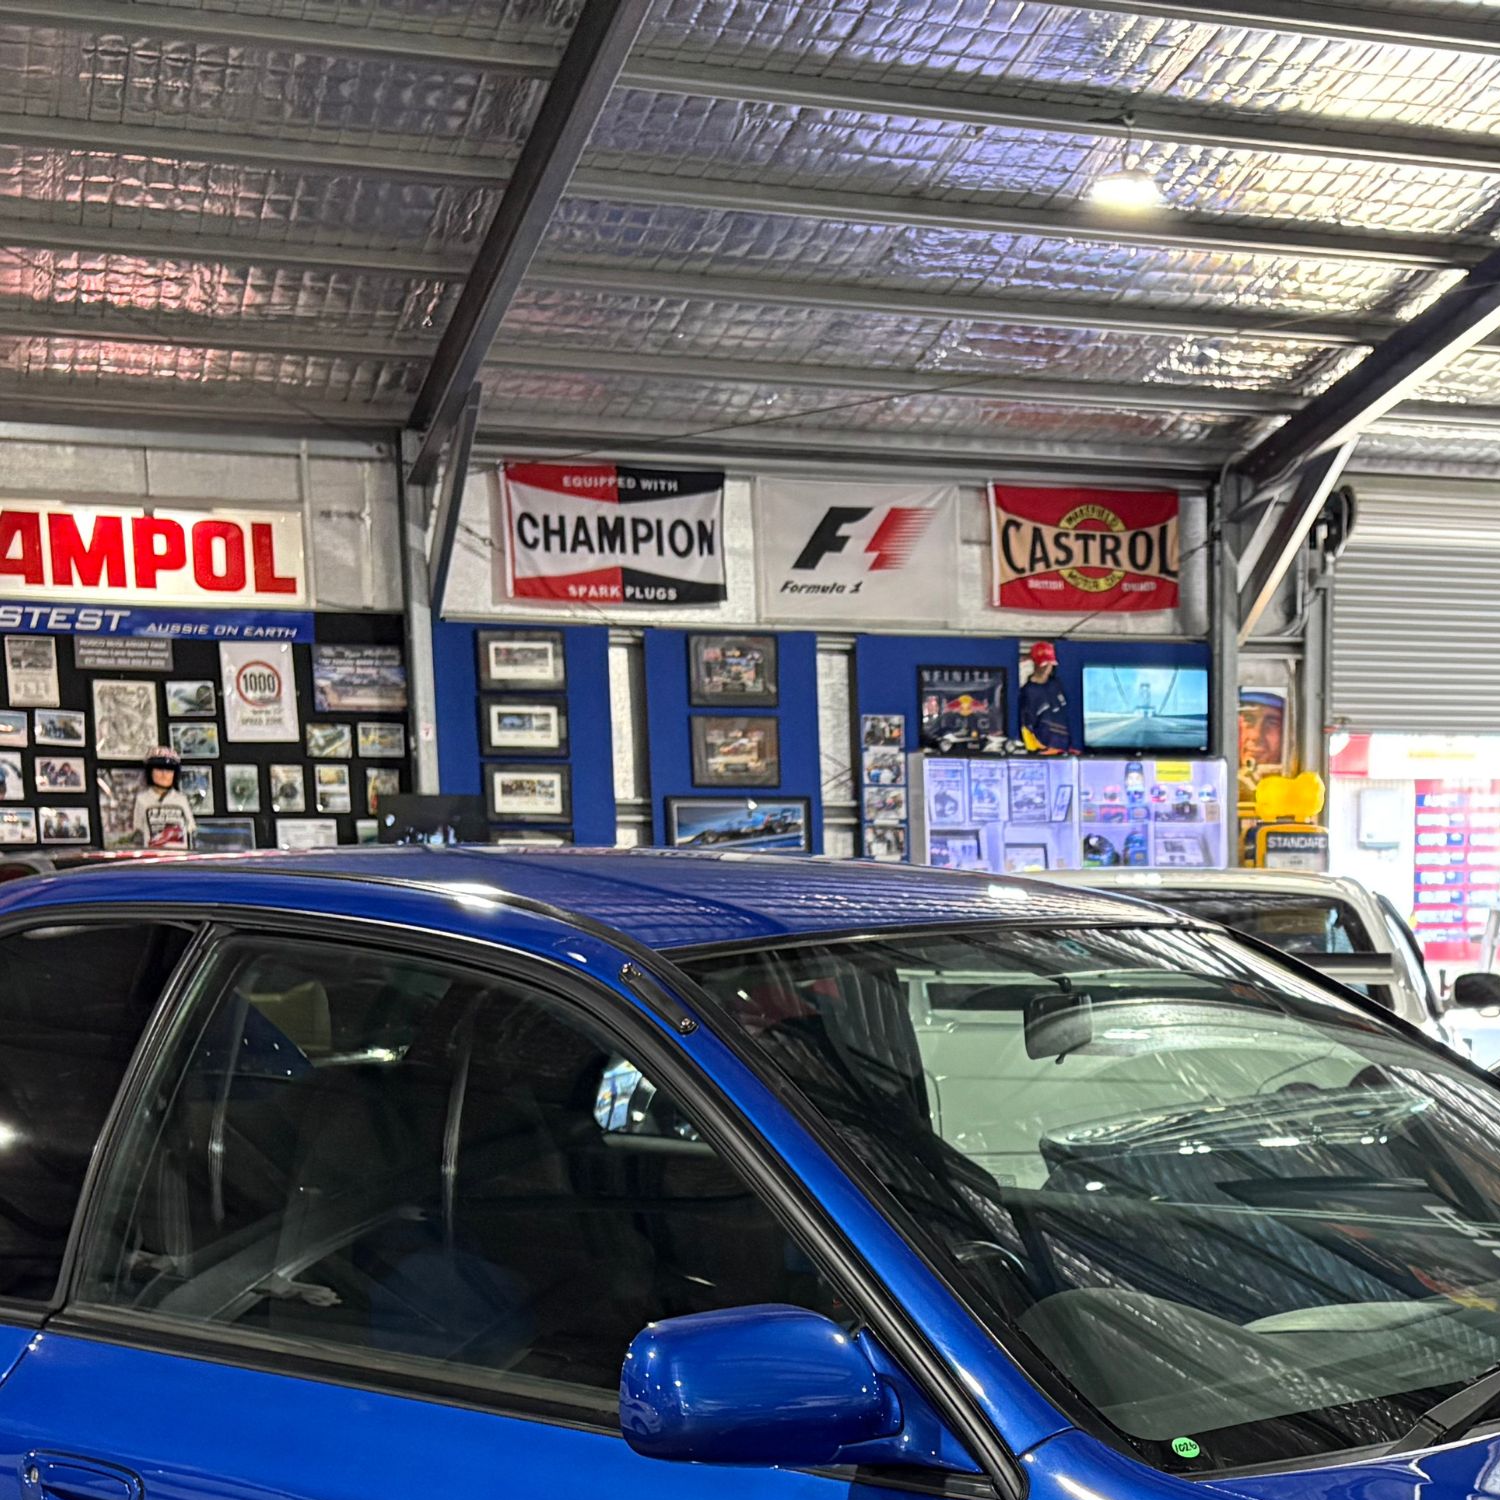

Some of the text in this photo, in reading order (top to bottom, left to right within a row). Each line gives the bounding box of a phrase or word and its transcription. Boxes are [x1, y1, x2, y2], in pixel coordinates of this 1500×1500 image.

[562, 475, 679, 491] EQUIPPED WITH
[517, 512, 715, 558] CHAMPION
[0, 511, 297, 594] AMPOL
[1002, 518, 1179, 578] CASTROL
[568, 584, 678, 600] SPARK PLUGS
[780, 580, 863, 594] Formula 1
[147, 622, 209, 636] AUSSIE
[214, 624, 239, 637] ON
[244, 625, 297, 638] EARTH
[242, 673, 276, 694] 1000
